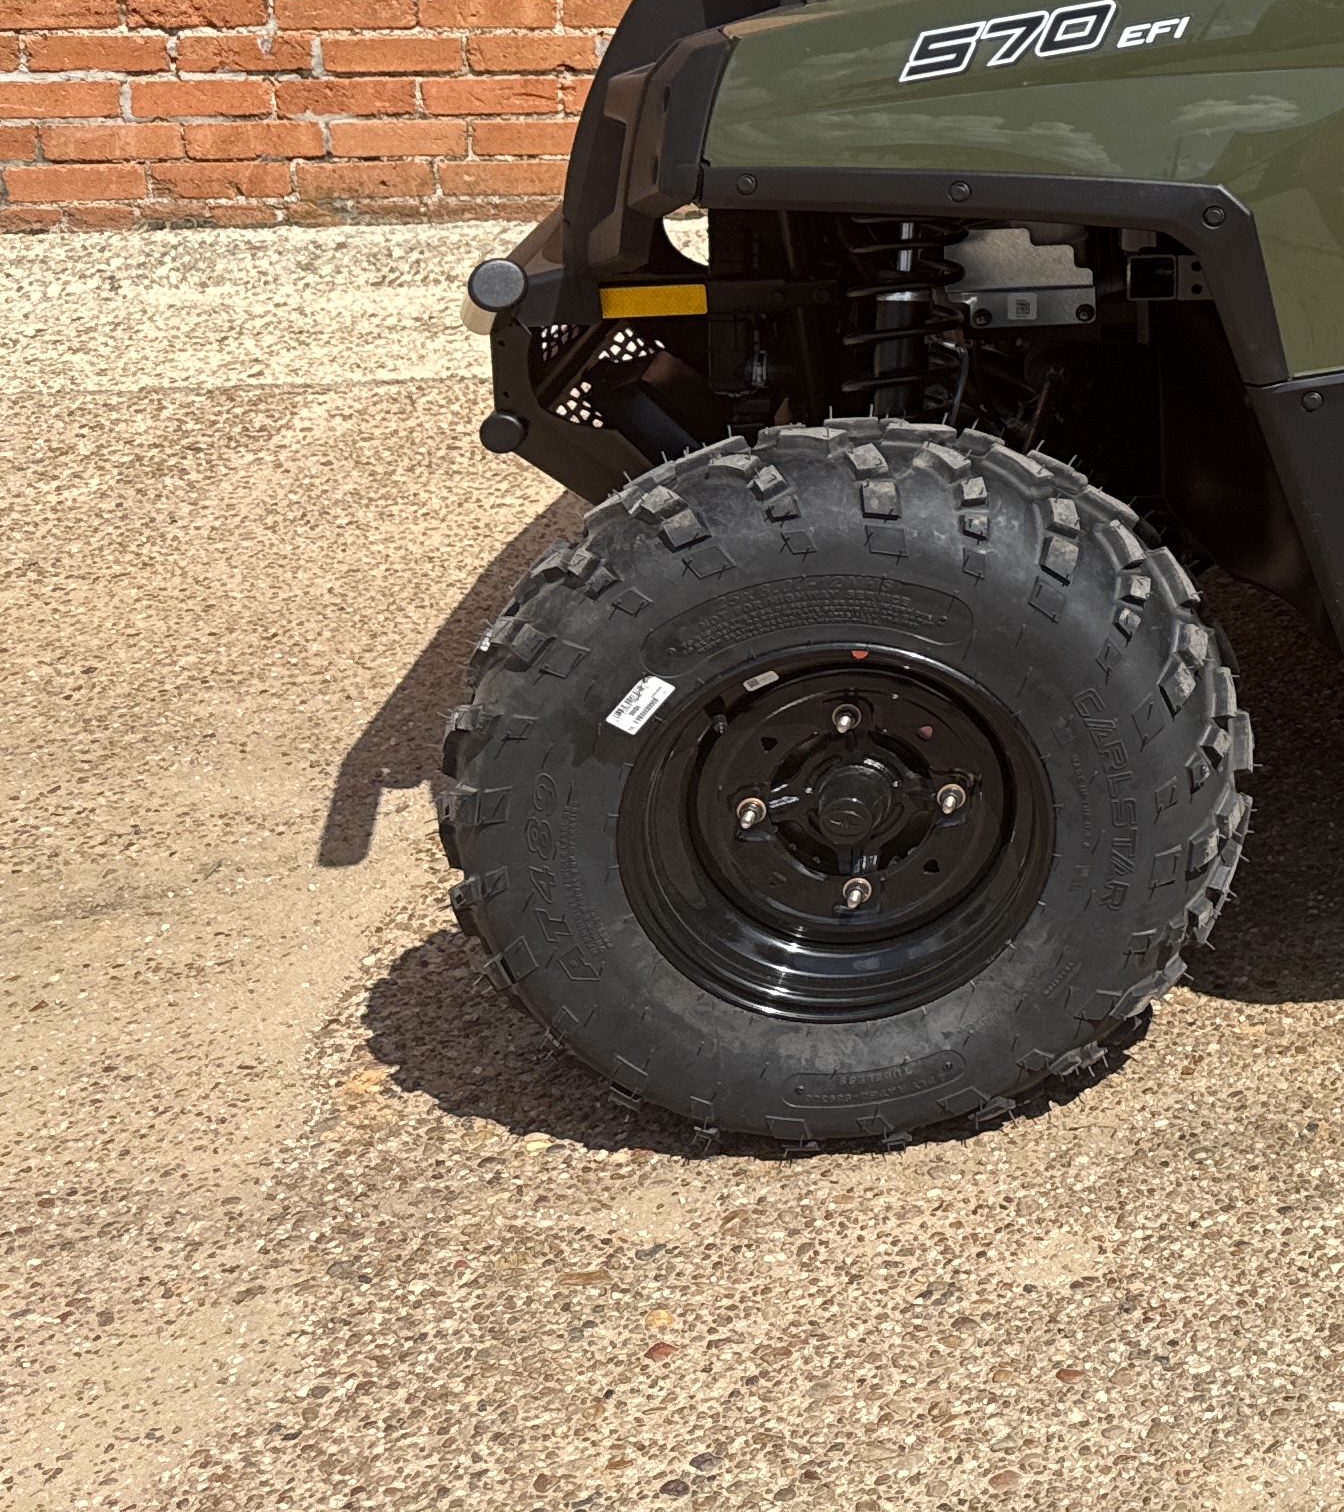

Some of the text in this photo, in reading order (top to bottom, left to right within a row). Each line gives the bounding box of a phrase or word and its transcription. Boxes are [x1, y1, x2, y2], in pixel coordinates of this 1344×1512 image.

[899, 0, 1190, 82] 570 EFI
[1072, 688, 1138, 911] CARLSTAR
